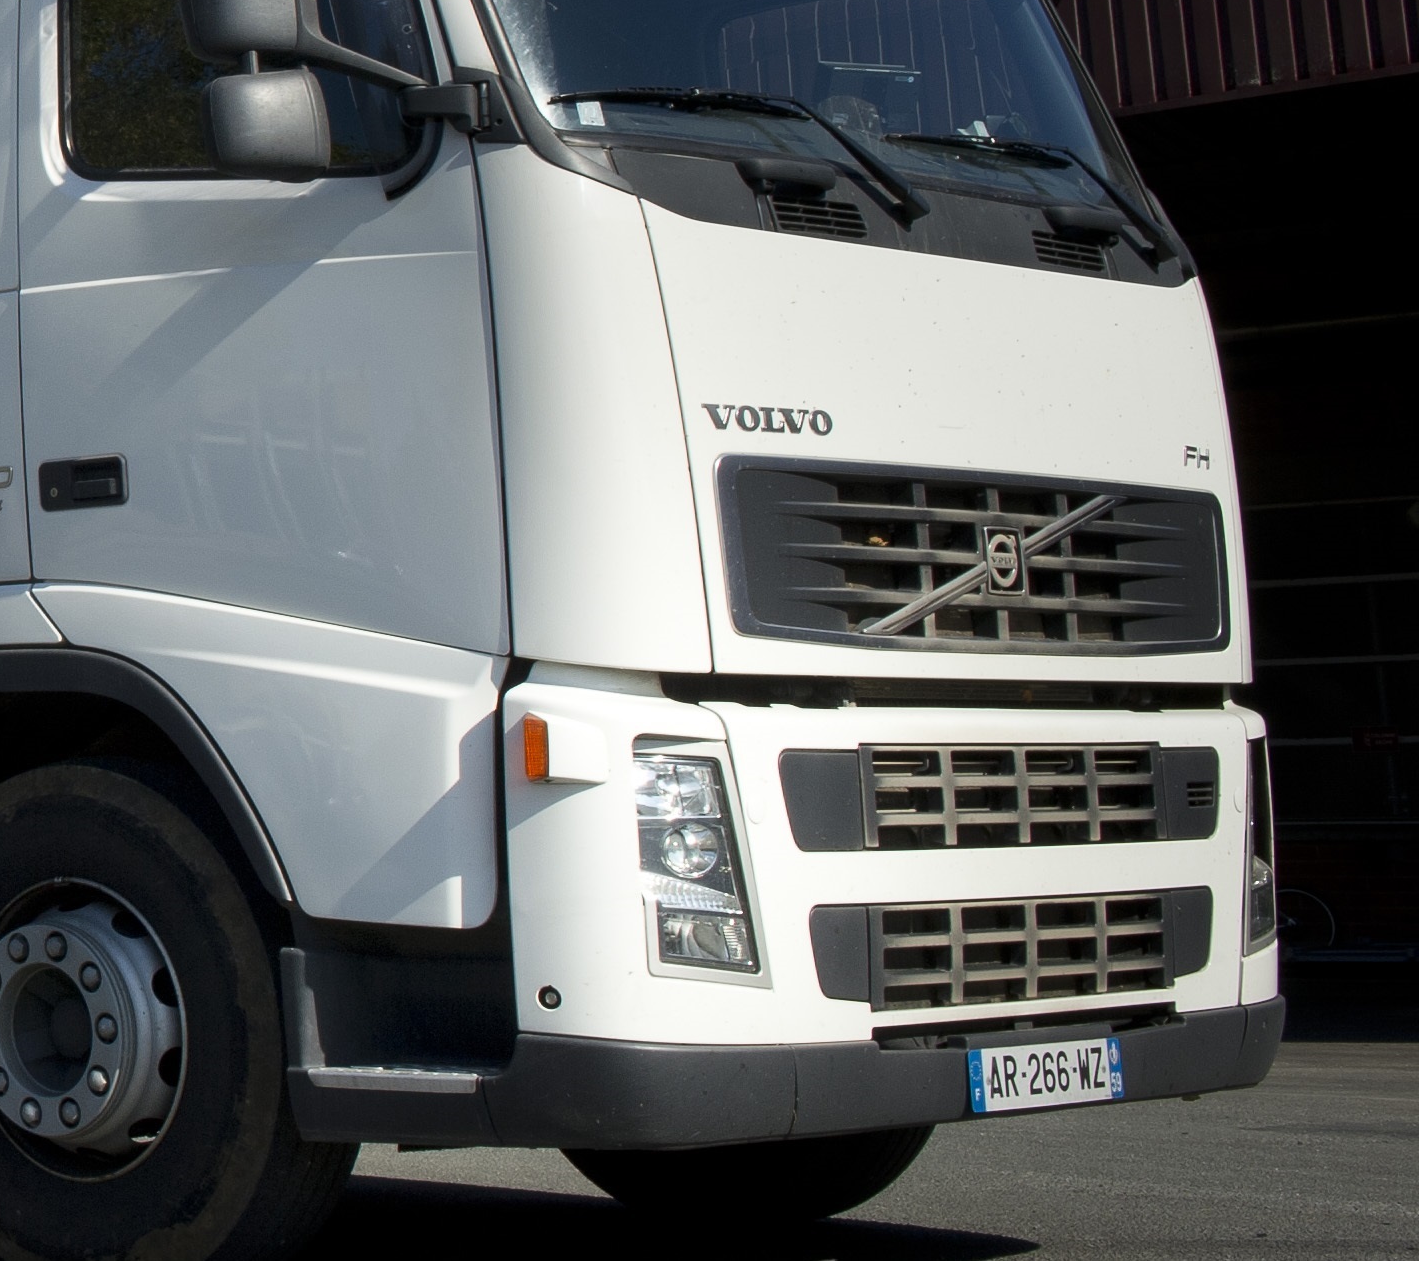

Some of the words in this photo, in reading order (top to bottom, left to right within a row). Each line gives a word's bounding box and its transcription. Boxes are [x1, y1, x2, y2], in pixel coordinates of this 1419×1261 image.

[701, 403, 833, 436] VOLVO
[1183, 445, 1210, 470] FH
[990, 1046, 1106, 1099] AR-266-WZ
[1110, 1071, 1122, 1093] 59
[974, 1088, 980, 1101] F
